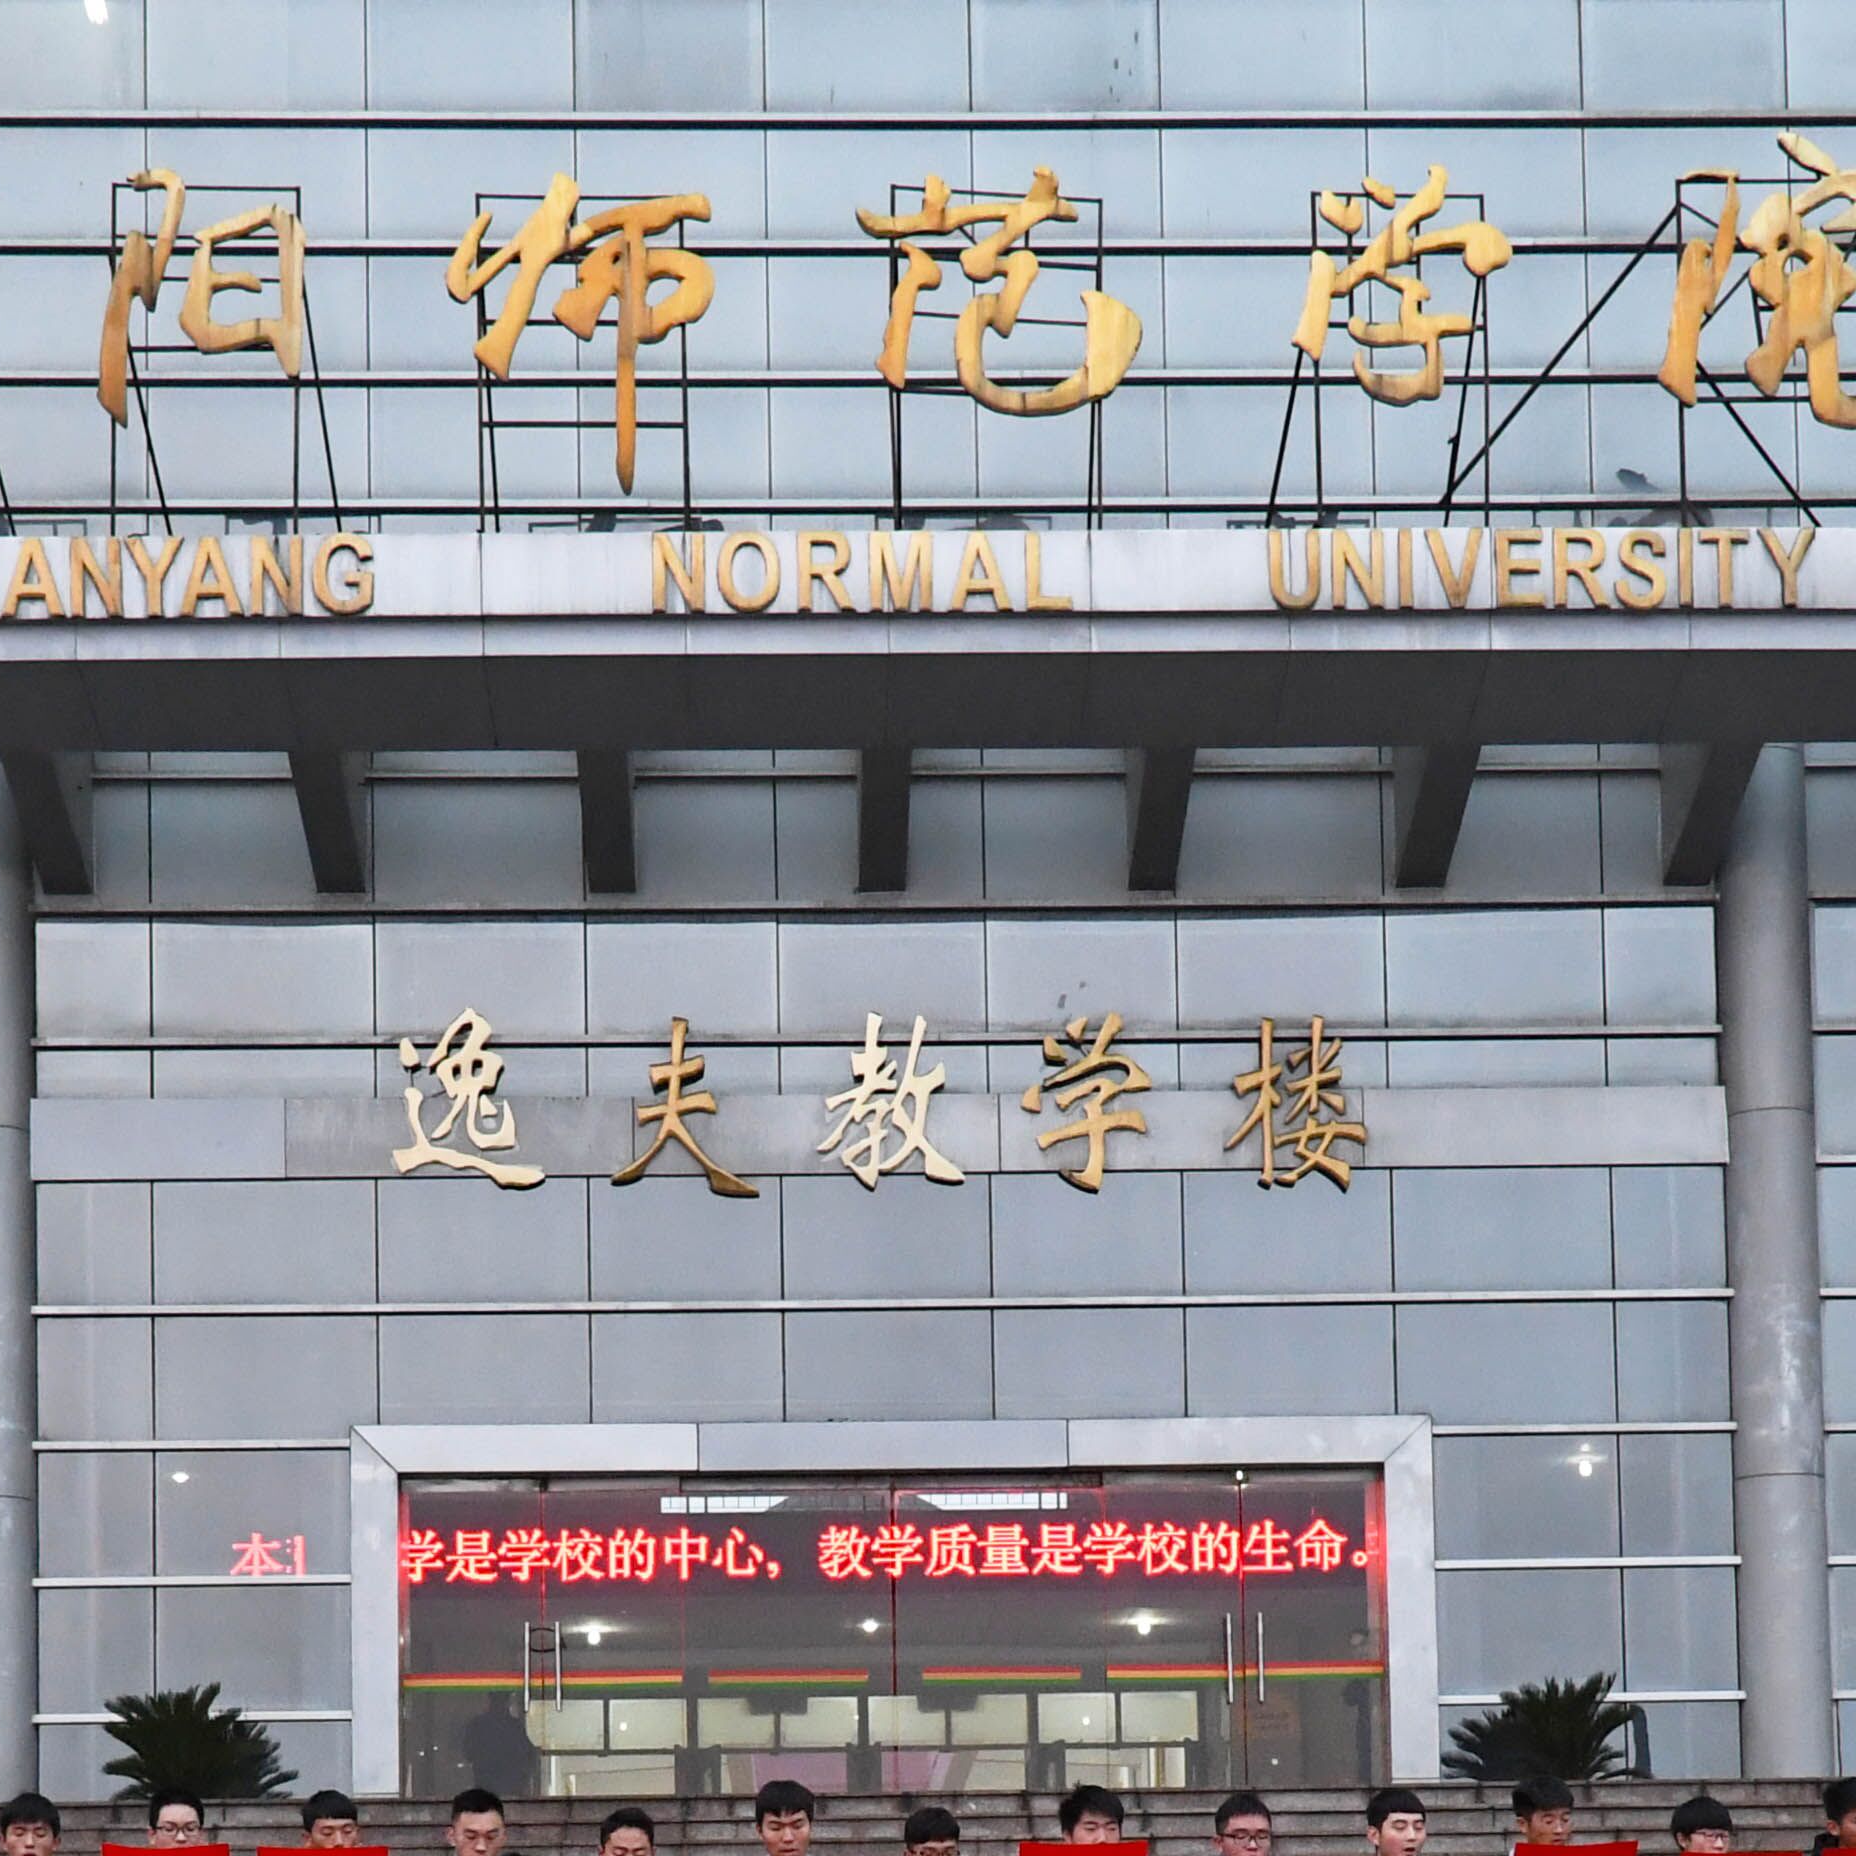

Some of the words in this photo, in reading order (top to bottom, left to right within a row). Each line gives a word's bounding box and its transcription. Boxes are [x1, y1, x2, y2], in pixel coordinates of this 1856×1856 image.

[650, 529, 1076, 614] NORMAL
[1266, 525, 1817, 611] UNIVERSITY
[391, 1006, 1367, 1198] 逸夫教学楼
